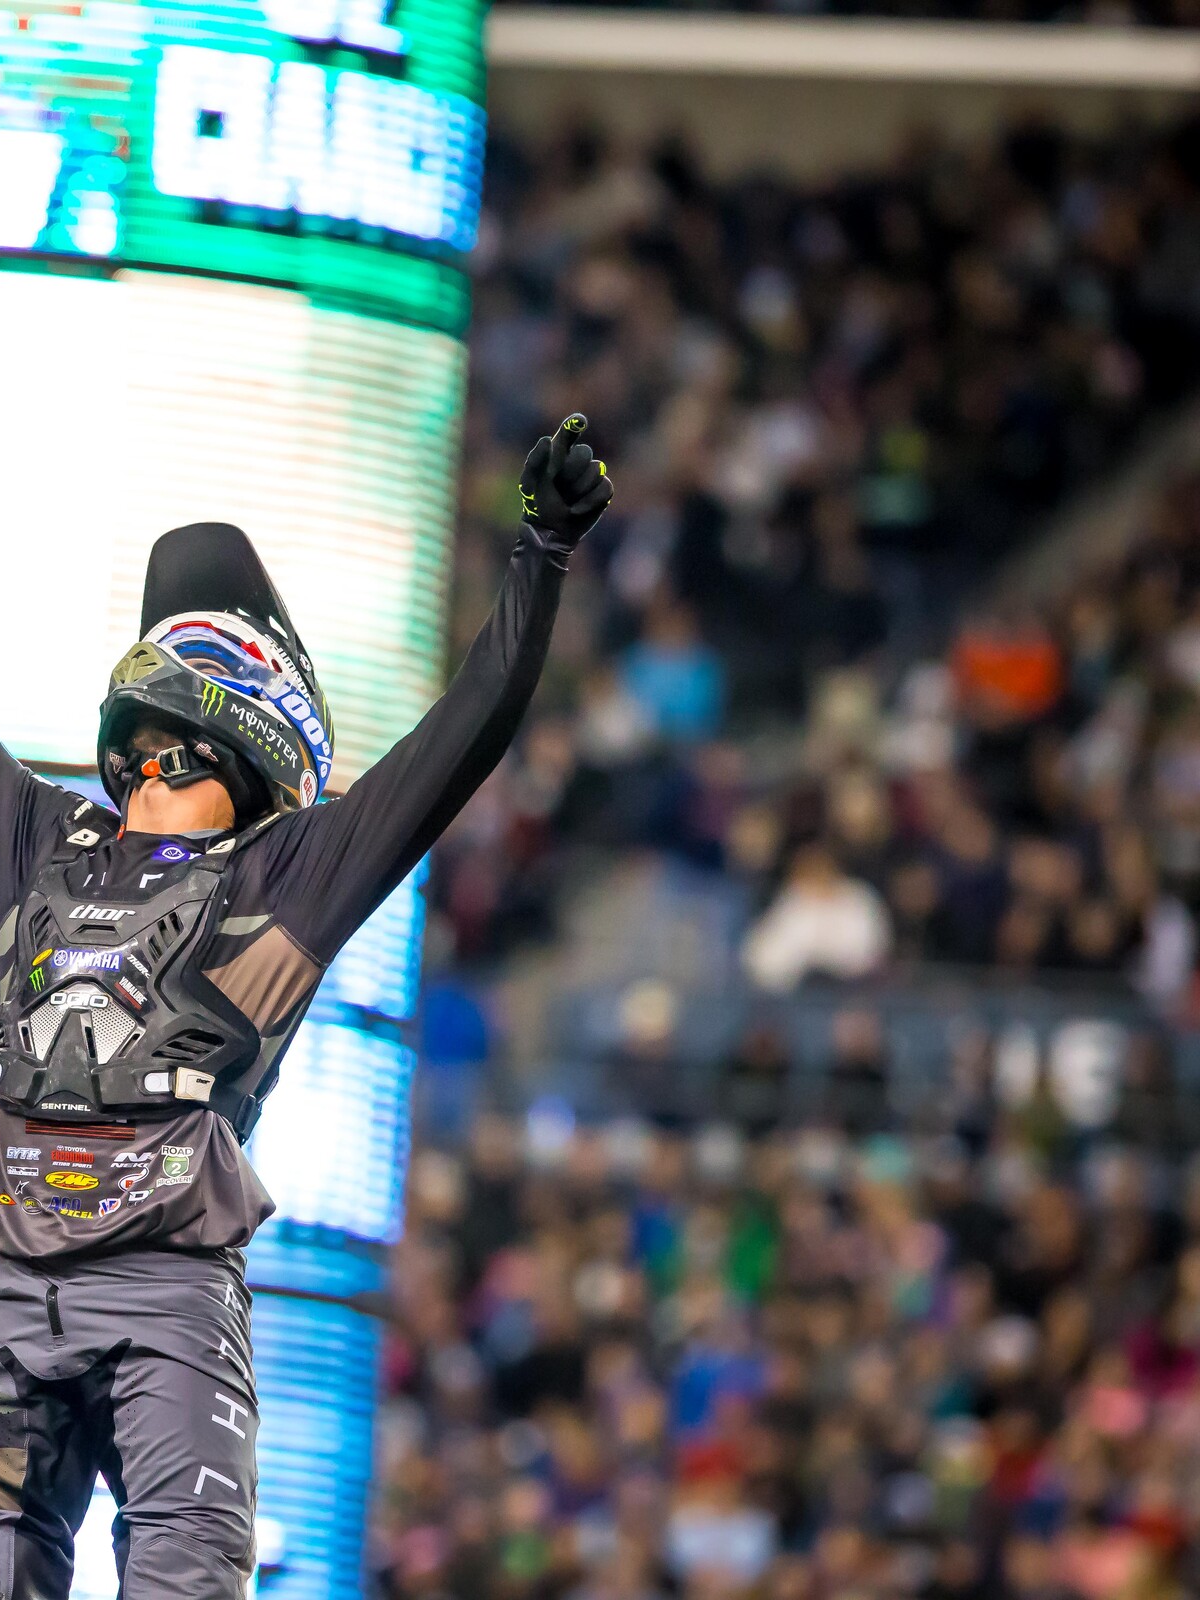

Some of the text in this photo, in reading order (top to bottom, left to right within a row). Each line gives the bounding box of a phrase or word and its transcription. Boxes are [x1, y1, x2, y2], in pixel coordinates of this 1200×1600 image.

[230, 703, 298, 768] MONSTER
[237, 724, 286, 767] ENERGY
[69, 905, 136, 921] thor
[69, 951, 120, 970] YAMAHA
[118, 976, 148, 1005] YAMALUBE
[41, 1103, 91, 1112] SENTINEL
[6, 1146, 42, 1161] GYTR
[162, 1146, 193, 1156] ROAD
[171, 1163, 181, 1175] 2
[45, 1173, 99, 1187] FMF
[60, 1208, 94, 1219] EXCEL
